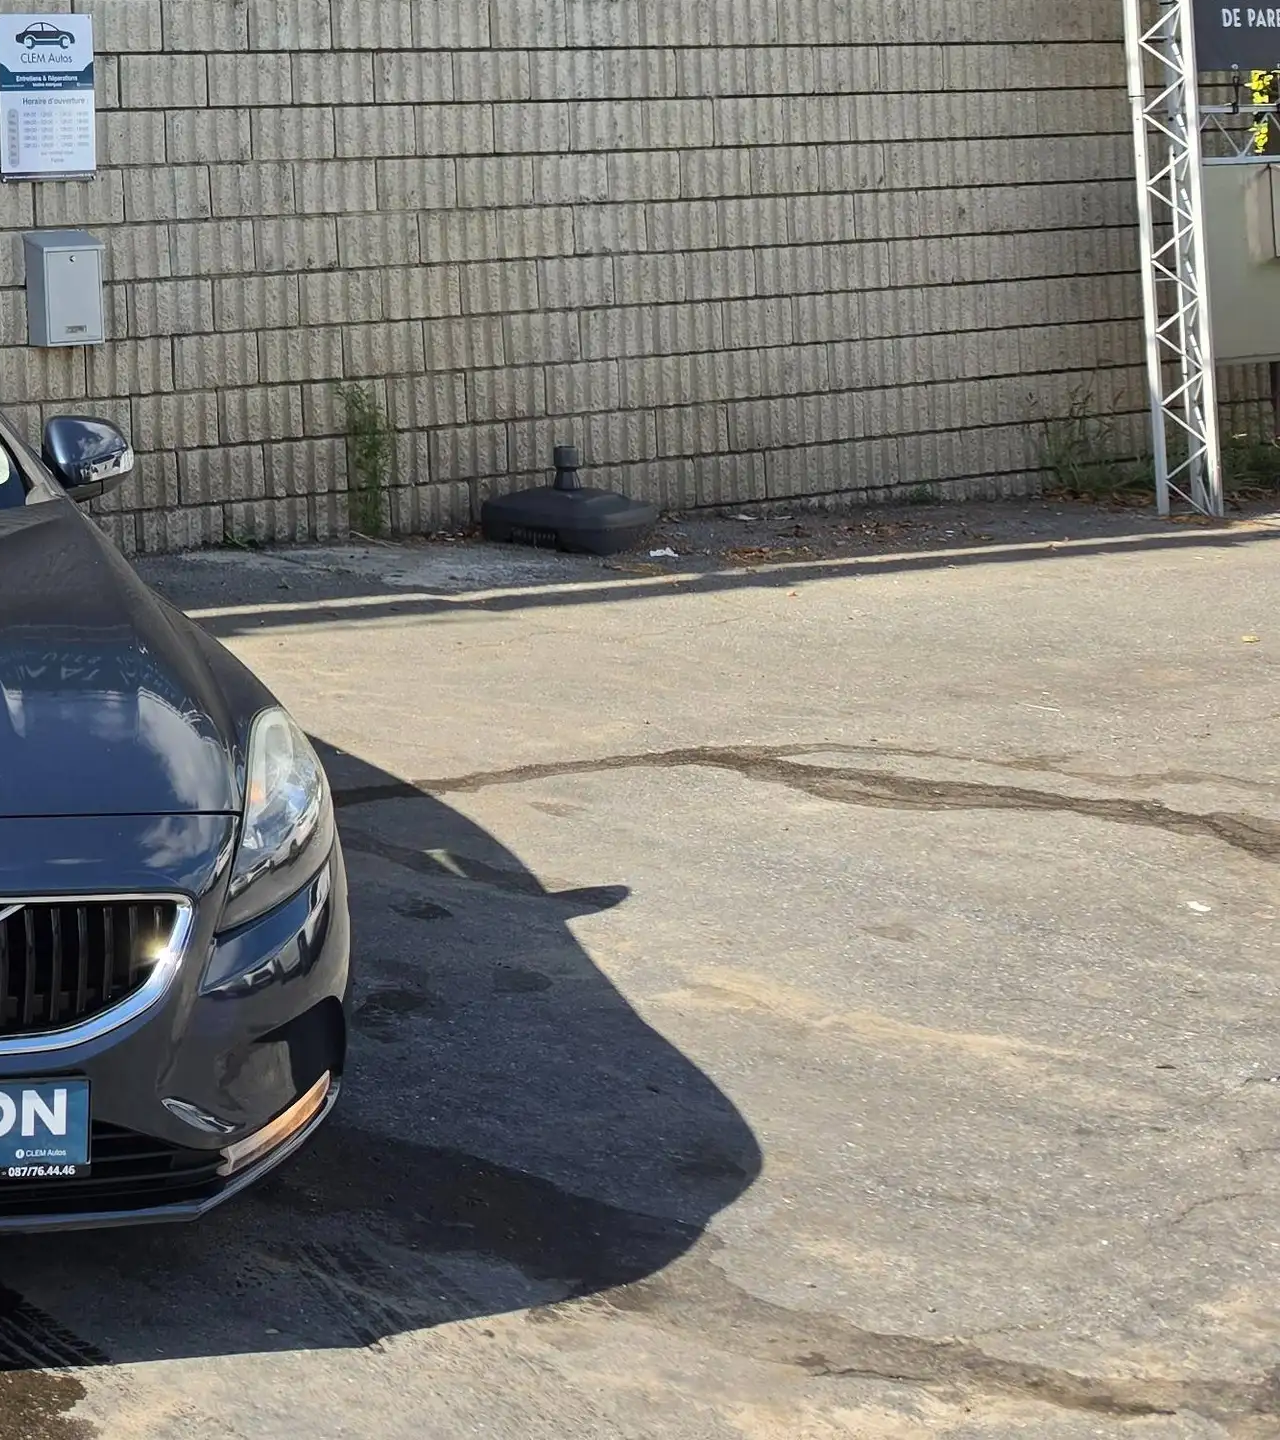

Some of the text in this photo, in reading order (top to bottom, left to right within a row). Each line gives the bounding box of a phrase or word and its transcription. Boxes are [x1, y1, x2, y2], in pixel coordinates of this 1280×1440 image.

[1222, 8, 1242, 27] DE
[20, 52, 72, 64] CLEM Autos
[26, 1148, 66, 1158] CLEM Autos
[8, 1165, 76, 1177] 087/76.44.46
